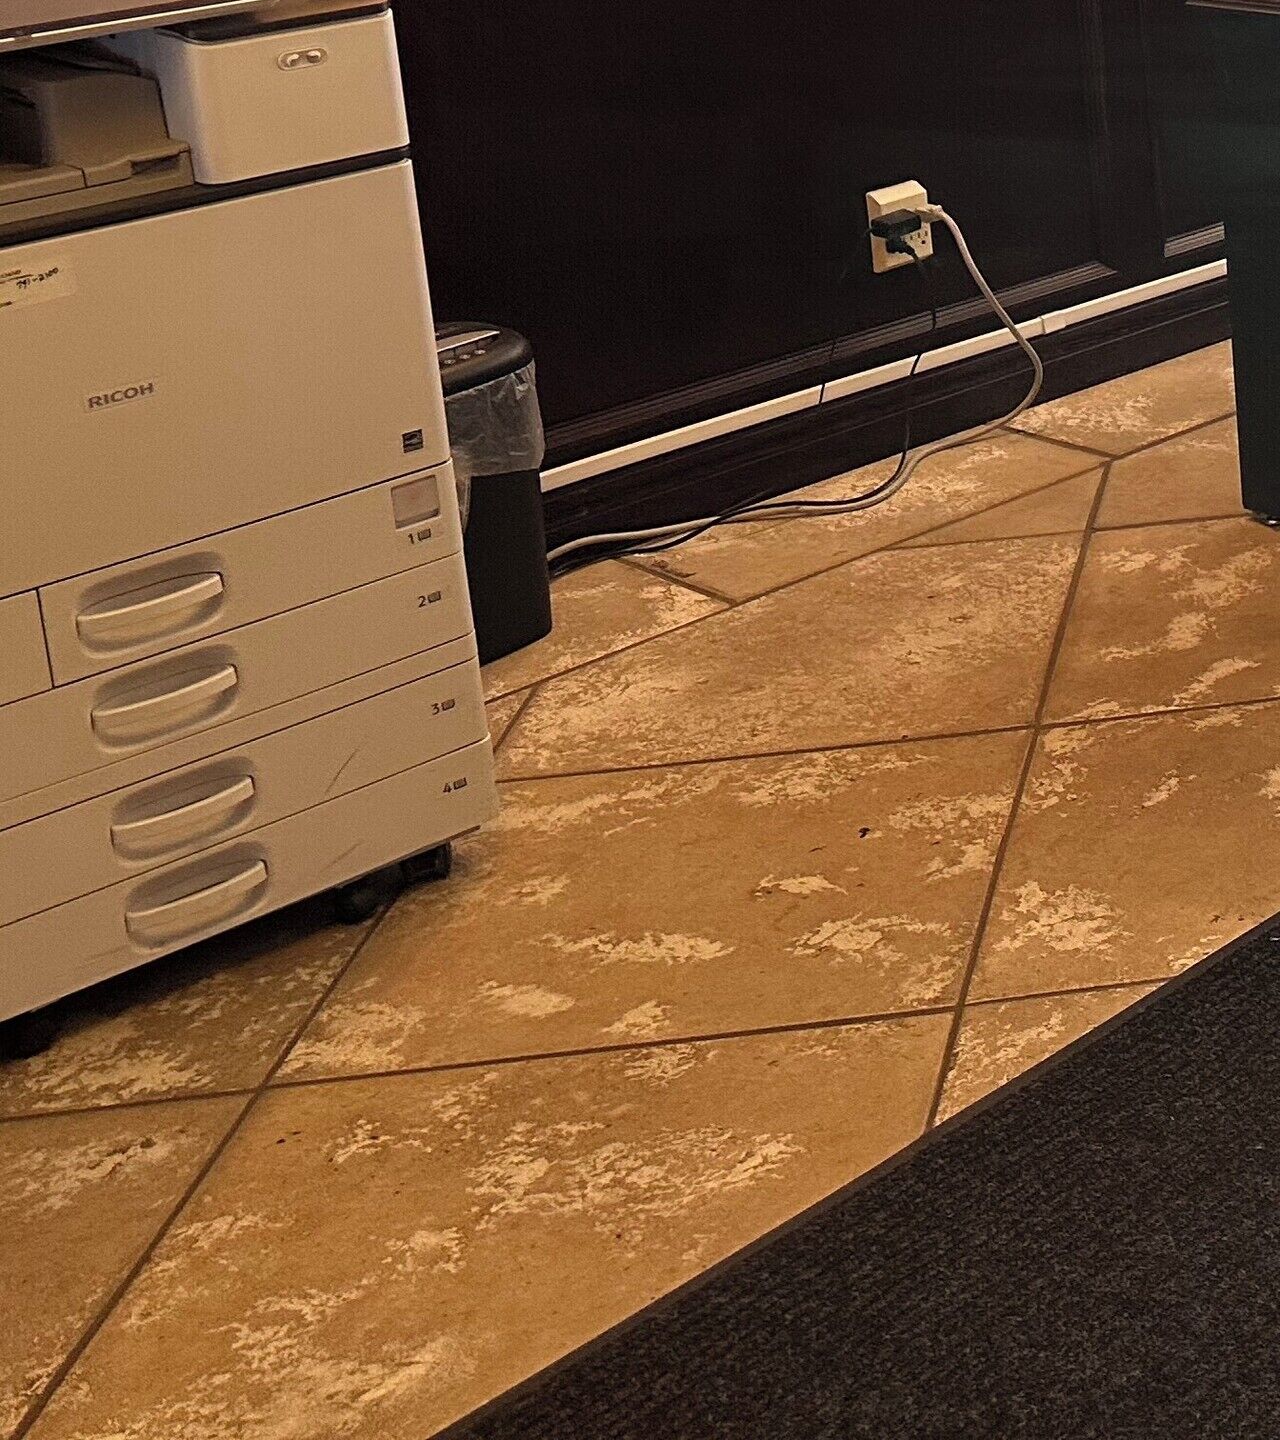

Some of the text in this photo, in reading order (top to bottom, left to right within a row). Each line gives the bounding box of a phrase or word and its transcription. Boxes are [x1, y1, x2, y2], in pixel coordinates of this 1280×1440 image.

[87, 381, 155, 409] RICOH
[407, 532, 416, 545] 1
[417, 595, 428, 608] 2
[430, 703, 441, 715] 3
[442, 782, 453, 794] 4
